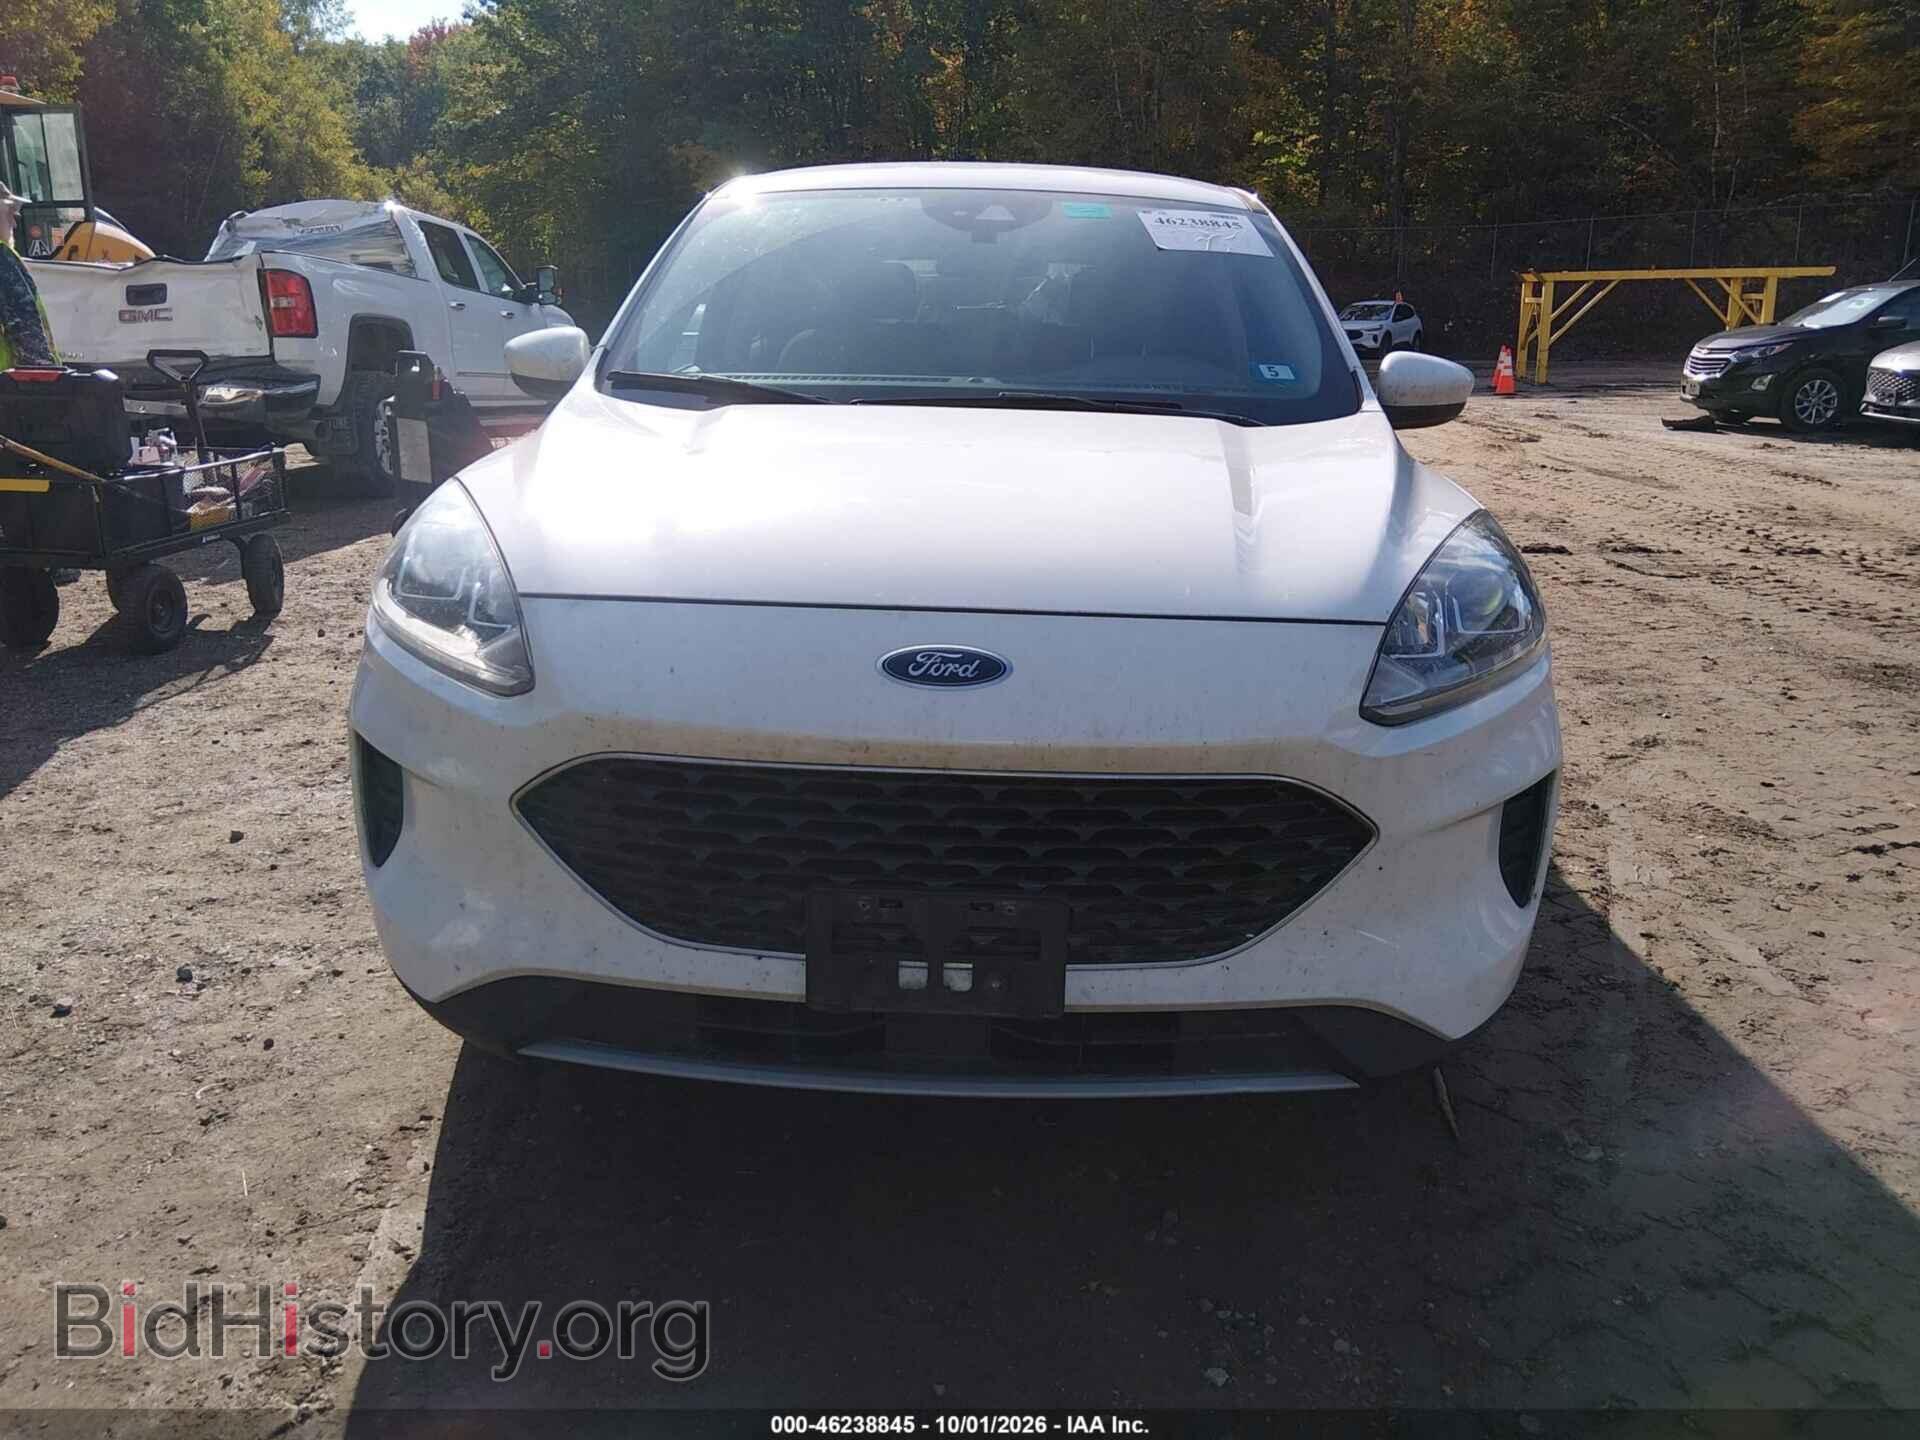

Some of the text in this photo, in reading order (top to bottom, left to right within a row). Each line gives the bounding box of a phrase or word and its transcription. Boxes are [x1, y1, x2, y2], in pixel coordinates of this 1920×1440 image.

[118, 307, 173, 324] GMC
[1267, 366, 1279, 377] 5
[908, 651, 981, 677] Ford
